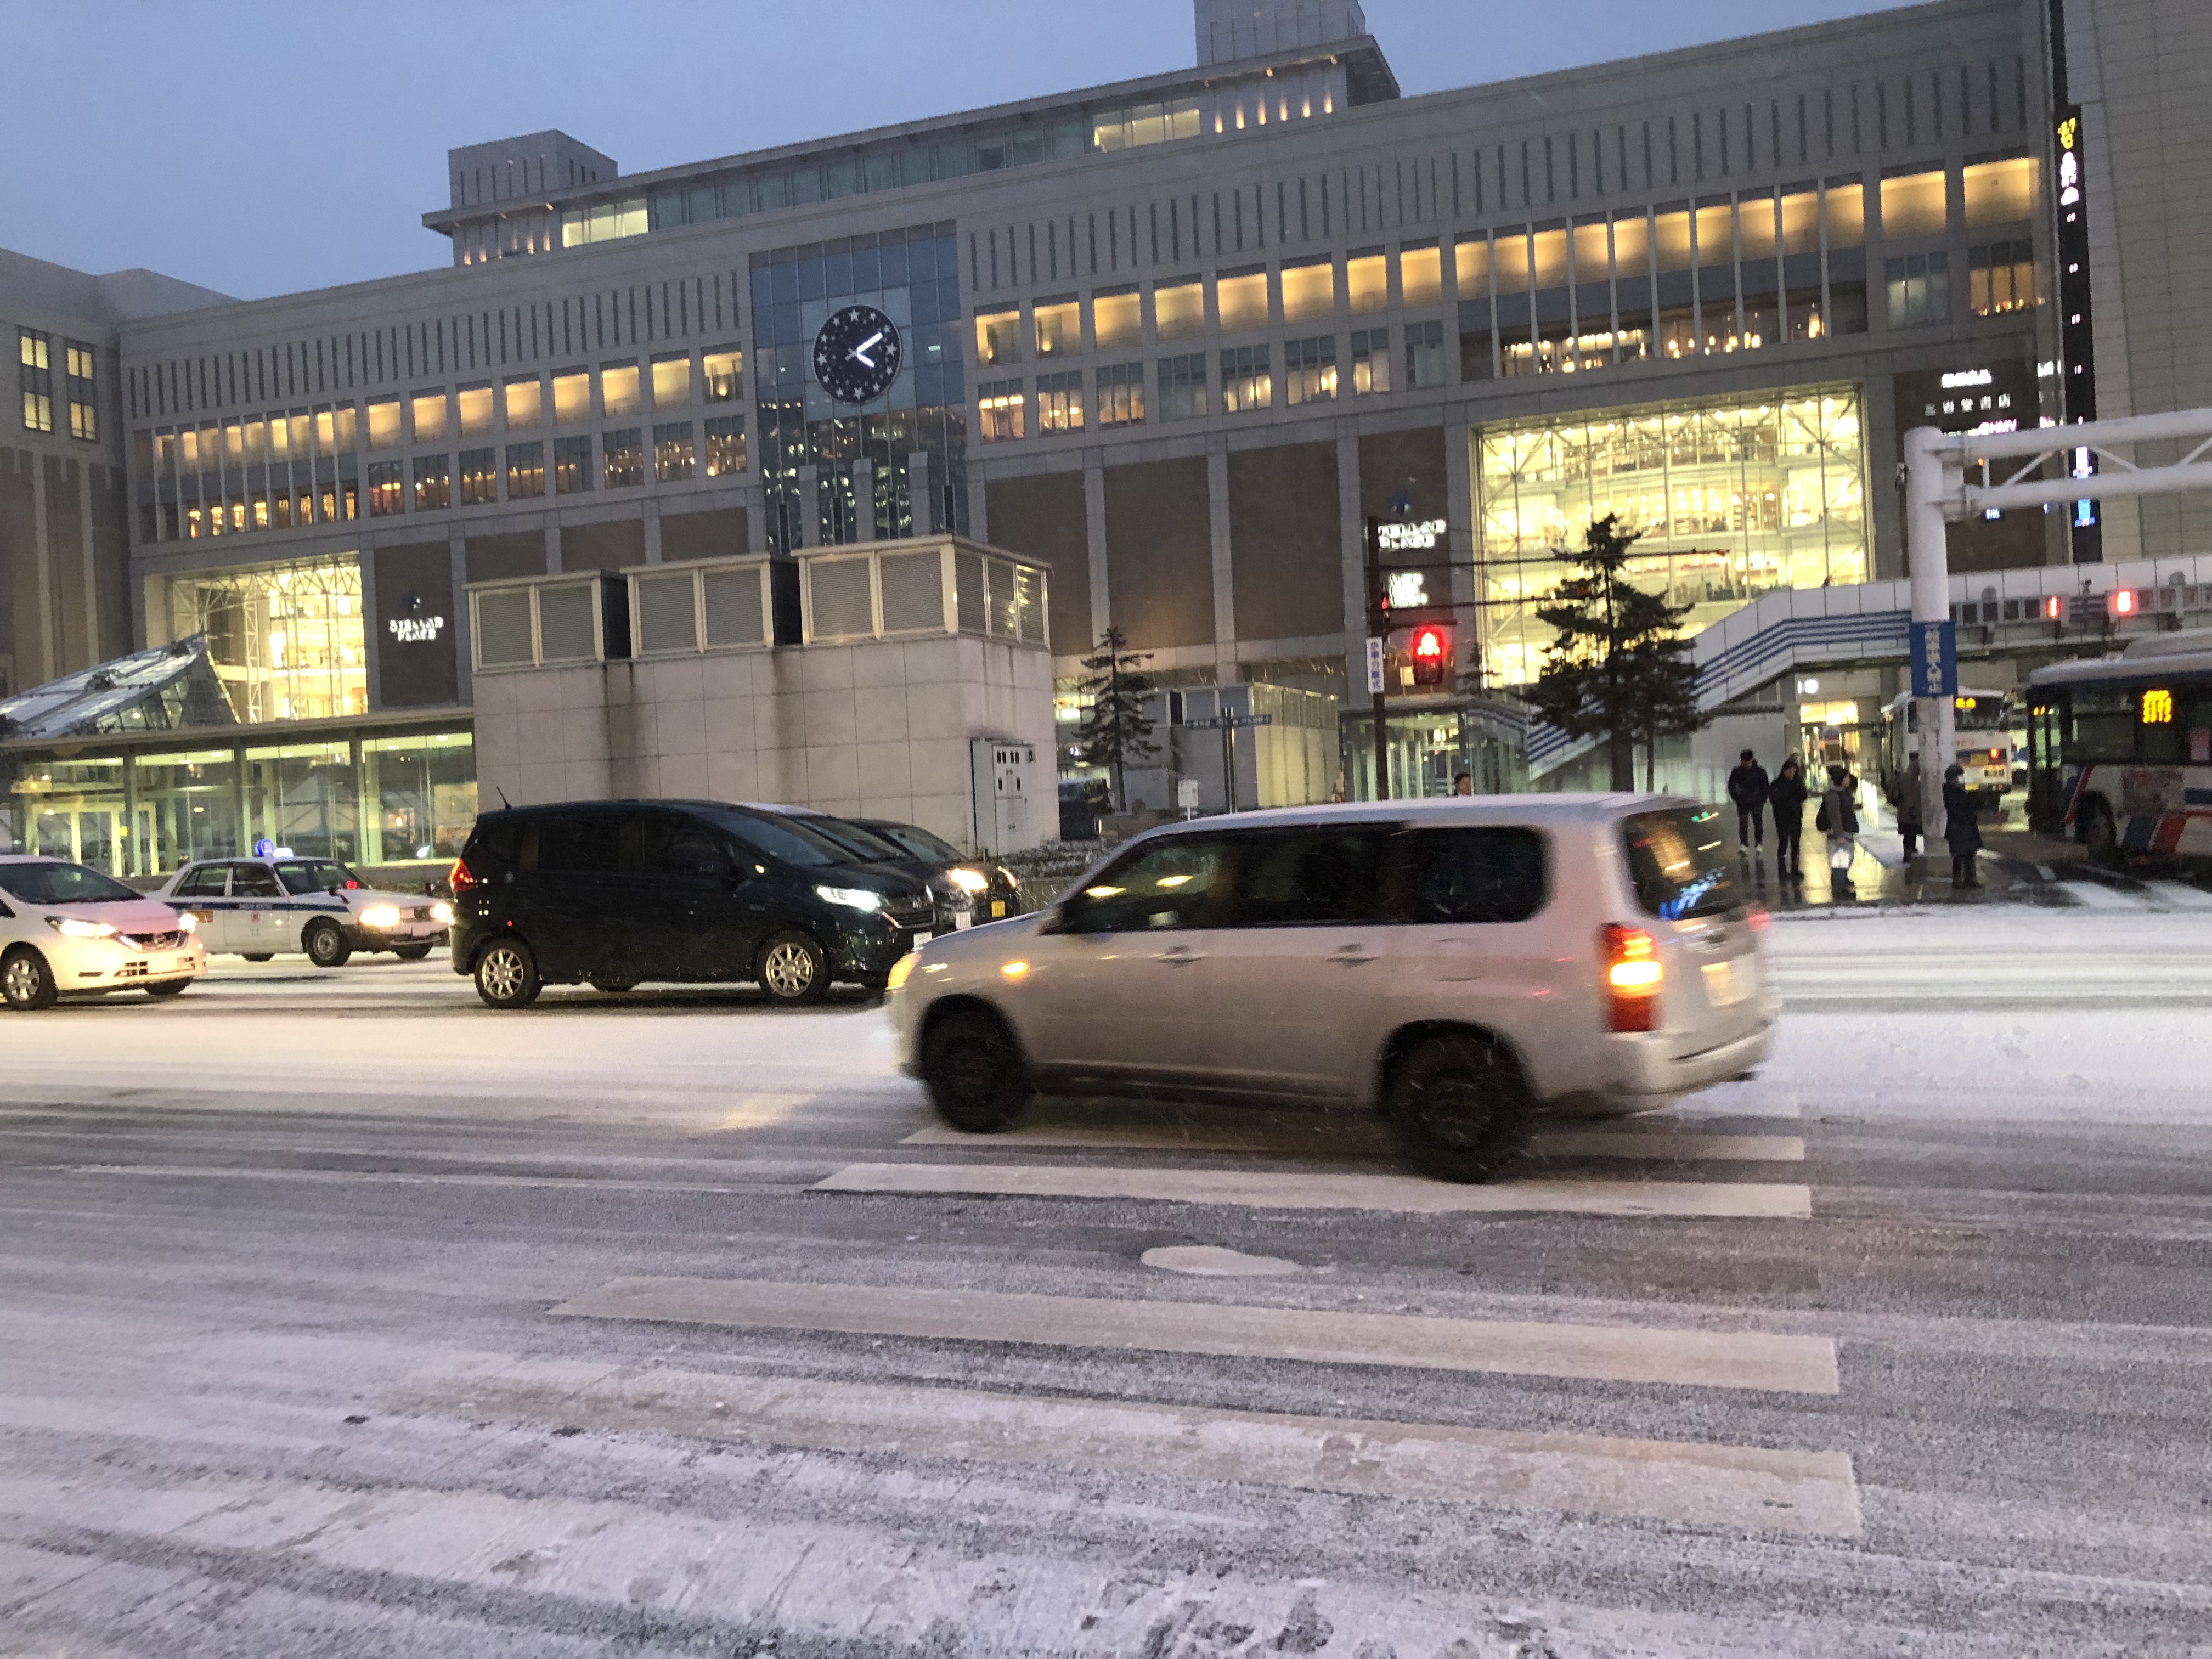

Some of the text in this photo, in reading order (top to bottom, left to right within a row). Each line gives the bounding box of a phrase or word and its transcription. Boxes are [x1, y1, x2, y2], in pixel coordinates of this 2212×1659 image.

[1364, 519, 1447, 538] TELLAR
[1378, 534, 1435, 549] PLACE
[389, 616, 444, 633] STELLAR
[398, 628, 437, 641] PLACE
